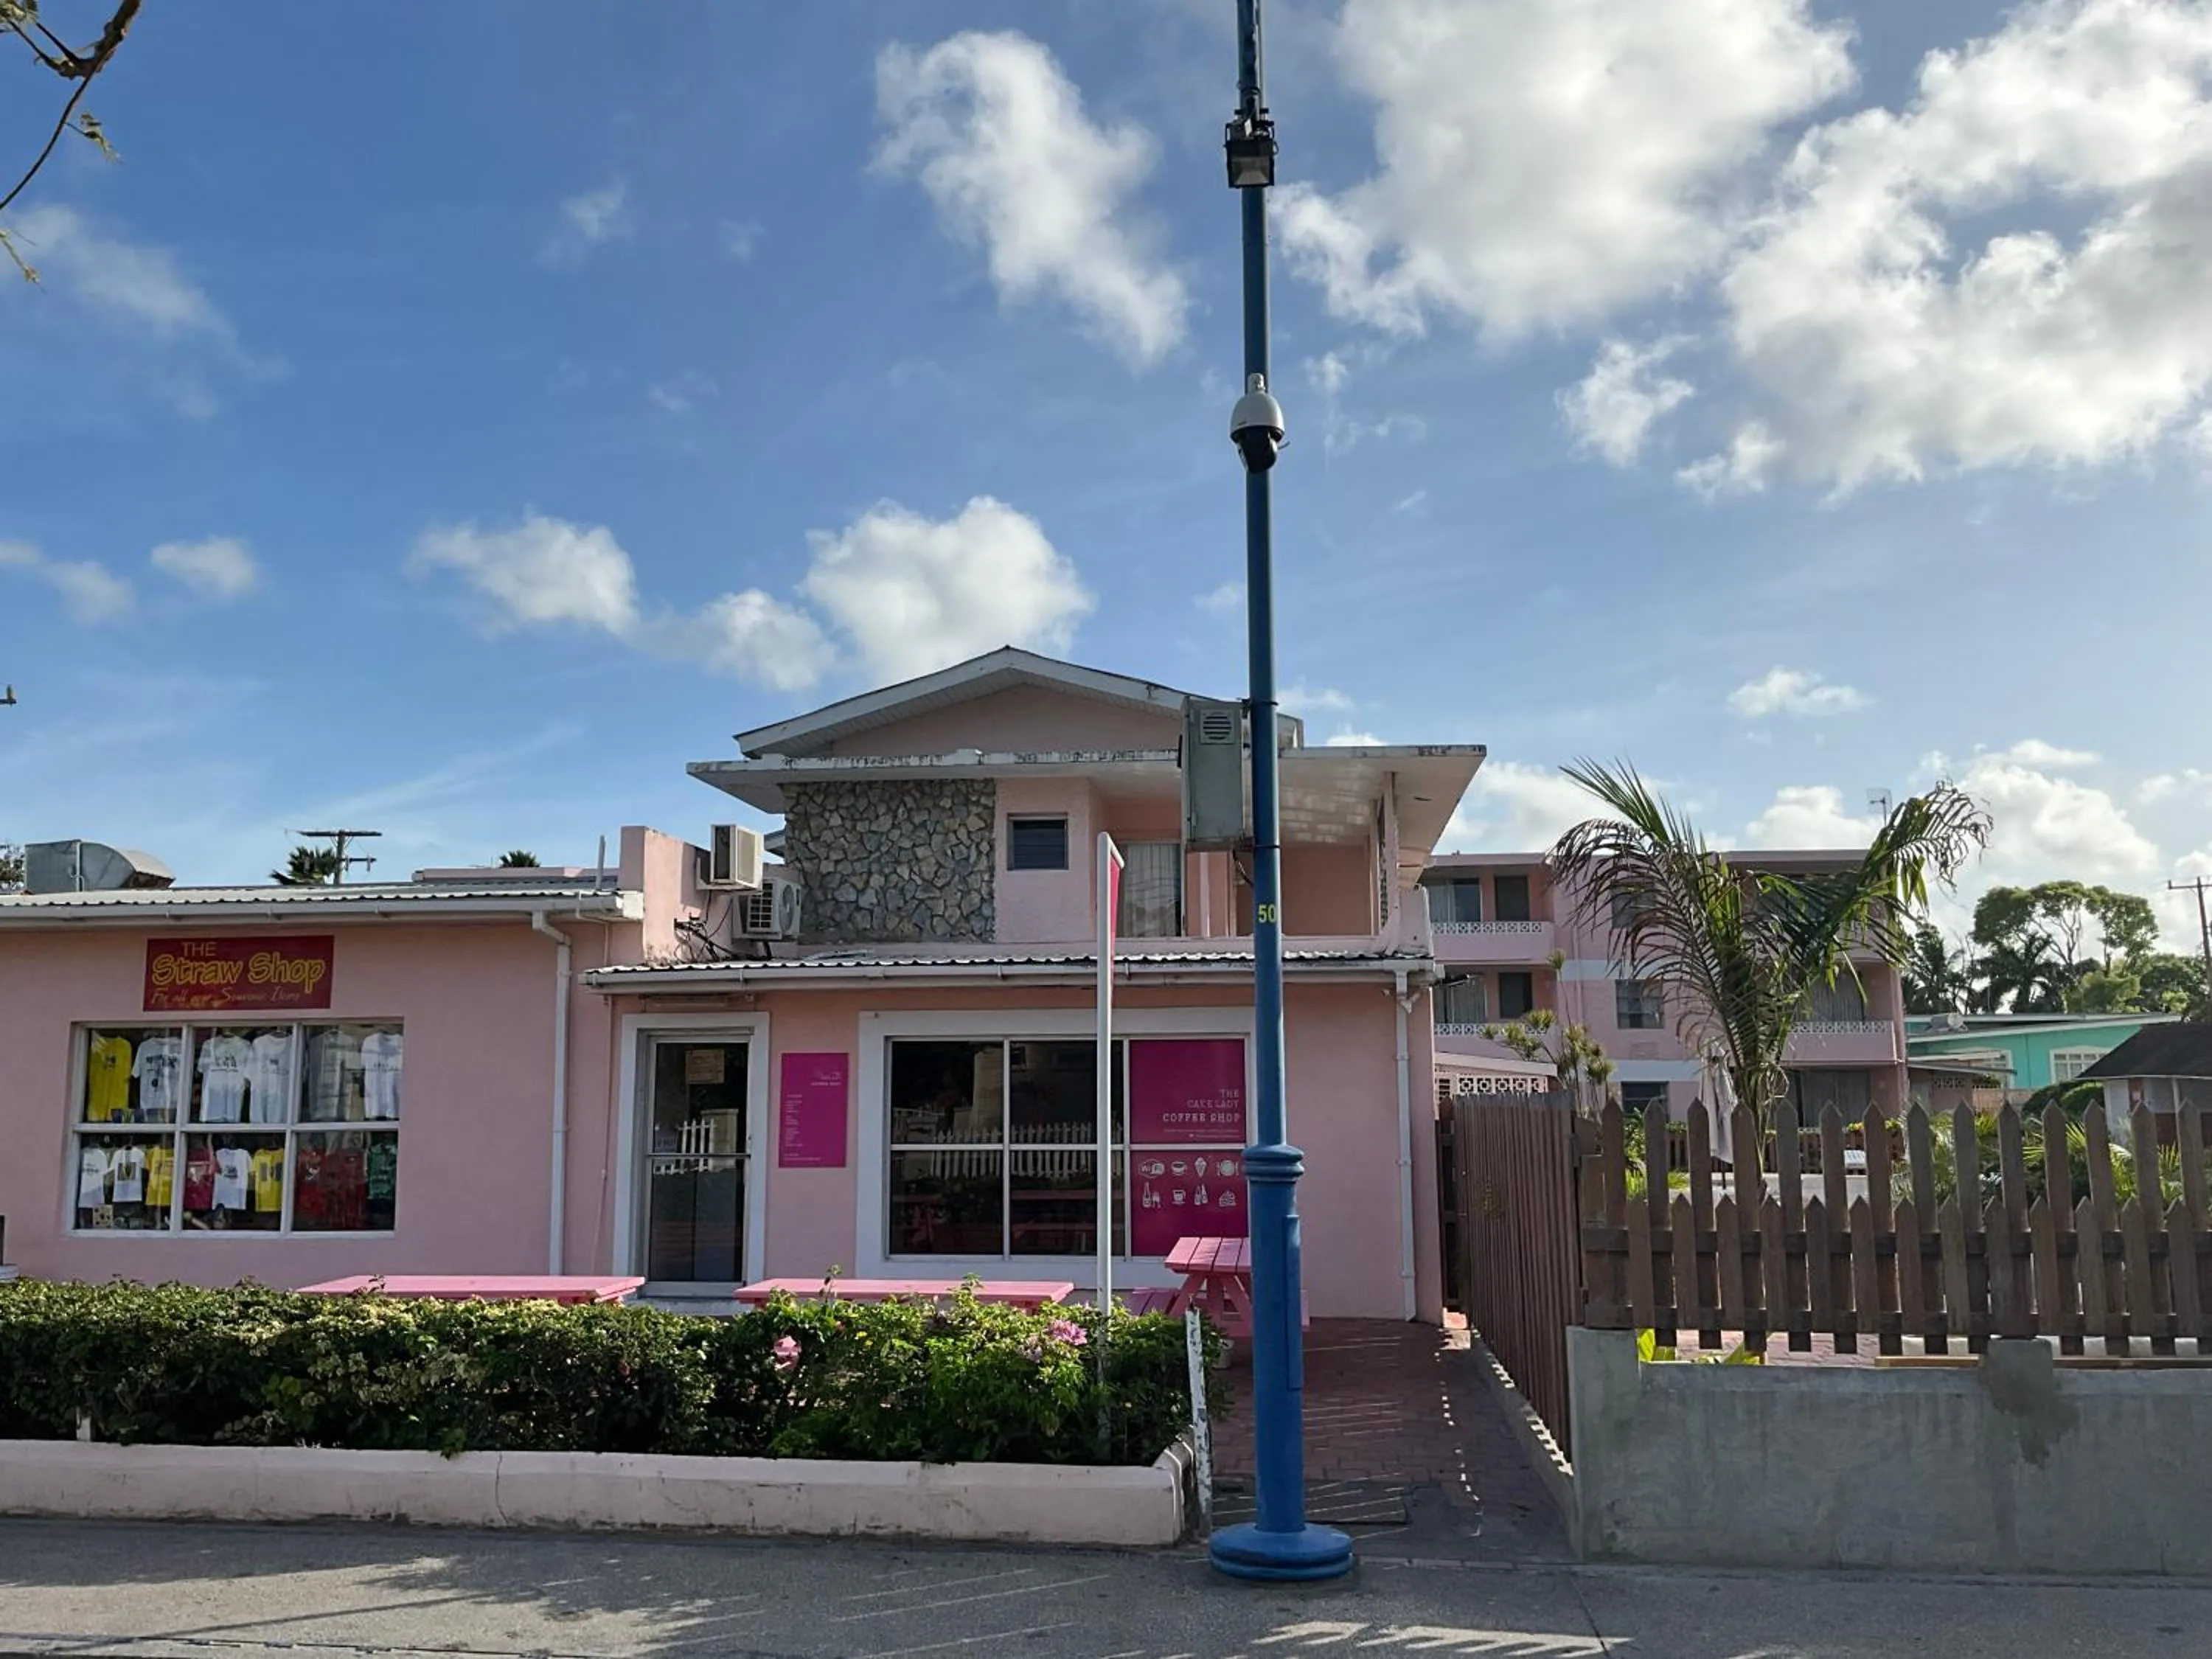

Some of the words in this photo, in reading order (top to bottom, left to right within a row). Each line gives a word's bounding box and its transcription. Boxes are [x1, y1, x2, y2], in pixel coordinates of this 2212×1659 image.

[1259, 904, 1276, 922] 50
[181, 942, 218, 956] THE
[152, 954, 243, 985] Straw
[248, 951, 325, 993] Shop
[1220, 1089, 1239, 1098] THE
[1187, 1099, 1213, 1108] CAKE
[1216, 1099, 1239, 1108] LADY
[1163, 1113, 1206, 1122] COFFEE
[1210, 1113, 1240, 1122] SHOP
